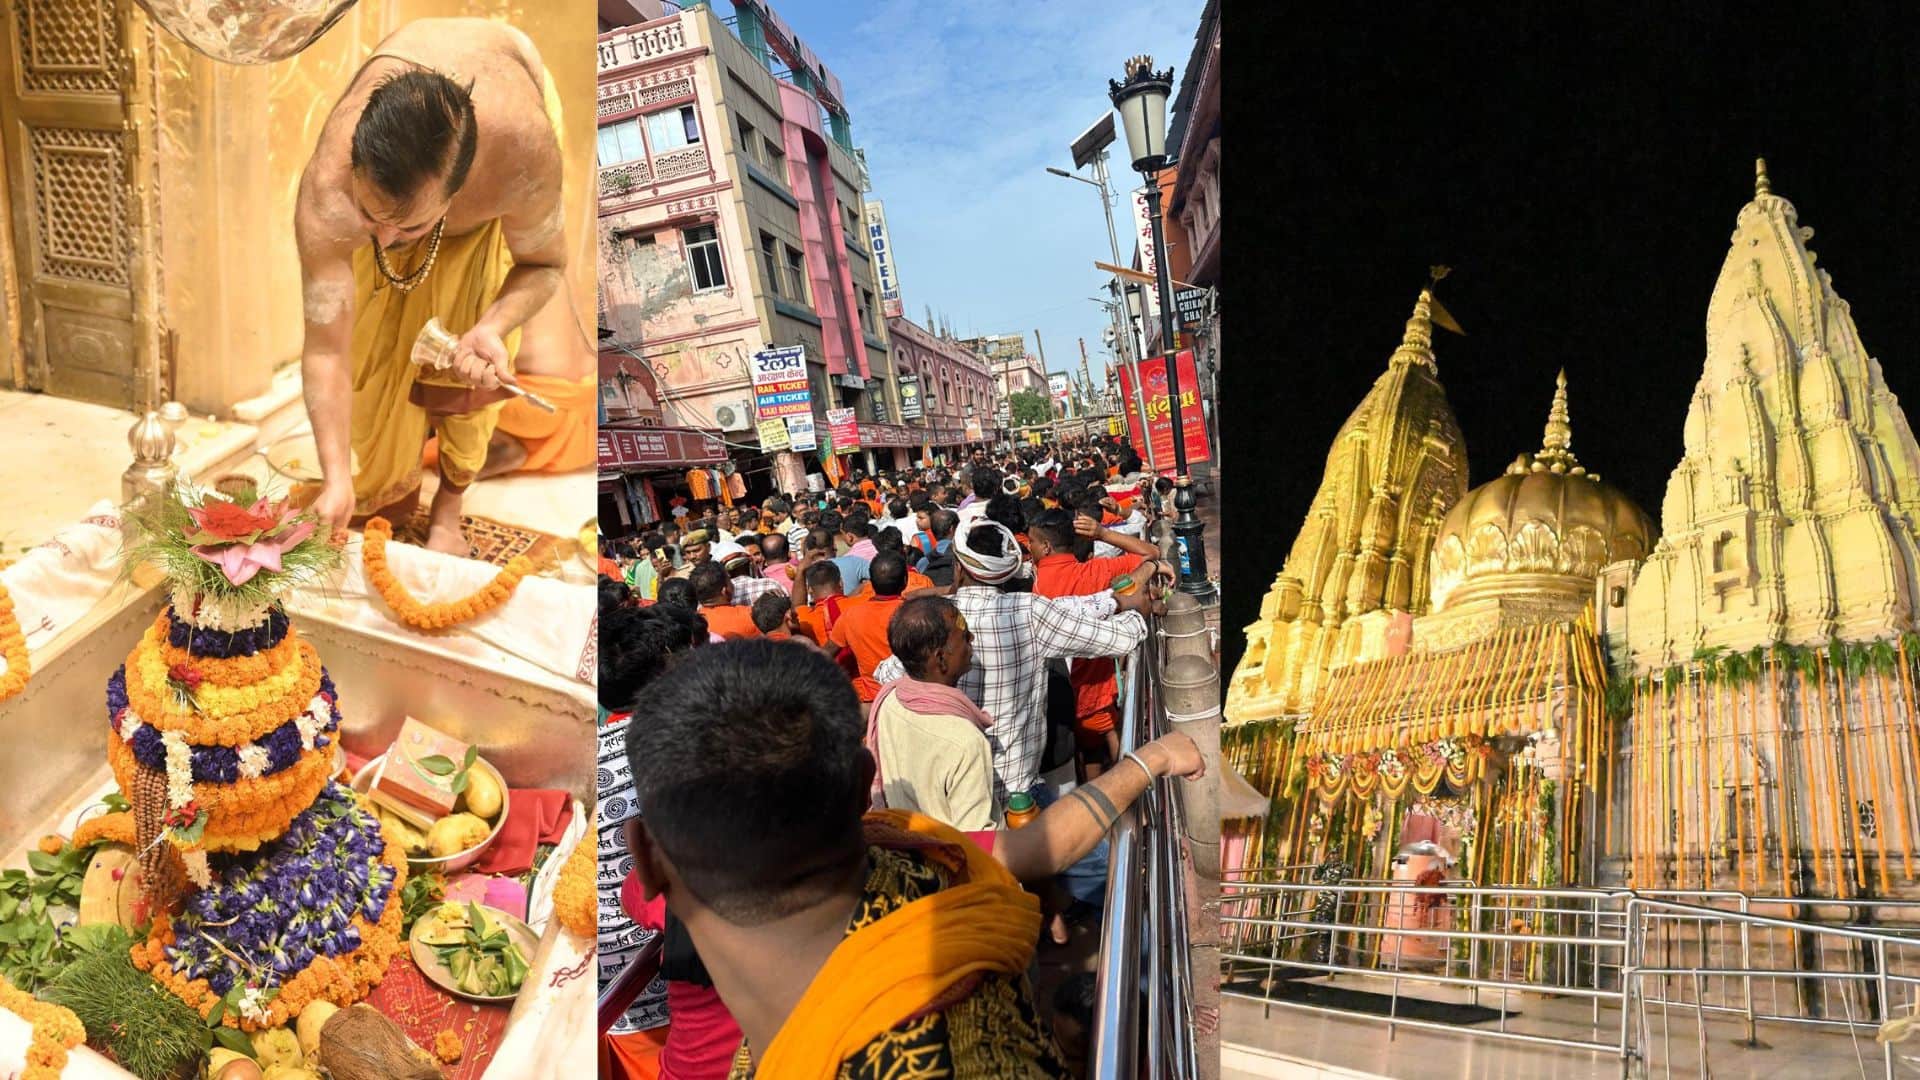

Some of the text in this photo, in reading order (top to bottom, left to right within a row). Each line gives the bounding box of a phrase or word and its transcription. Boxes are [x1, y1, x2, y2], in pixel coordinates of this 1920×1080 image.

[870, 225, 889, 290] HOTEL
[1176, 289, 1201, 301] LUCKNO
[1179, 299, 1201, 312] CHIKA
[1184, 310, 1200, 322] GHA
[757, 381, 807, 394] RAIL TICKET
[760, 392, 809, 405] AIR TICKET
[905, 397, 917, 405] AC
[761, 404, 809, 416] TAXI BOOKING
